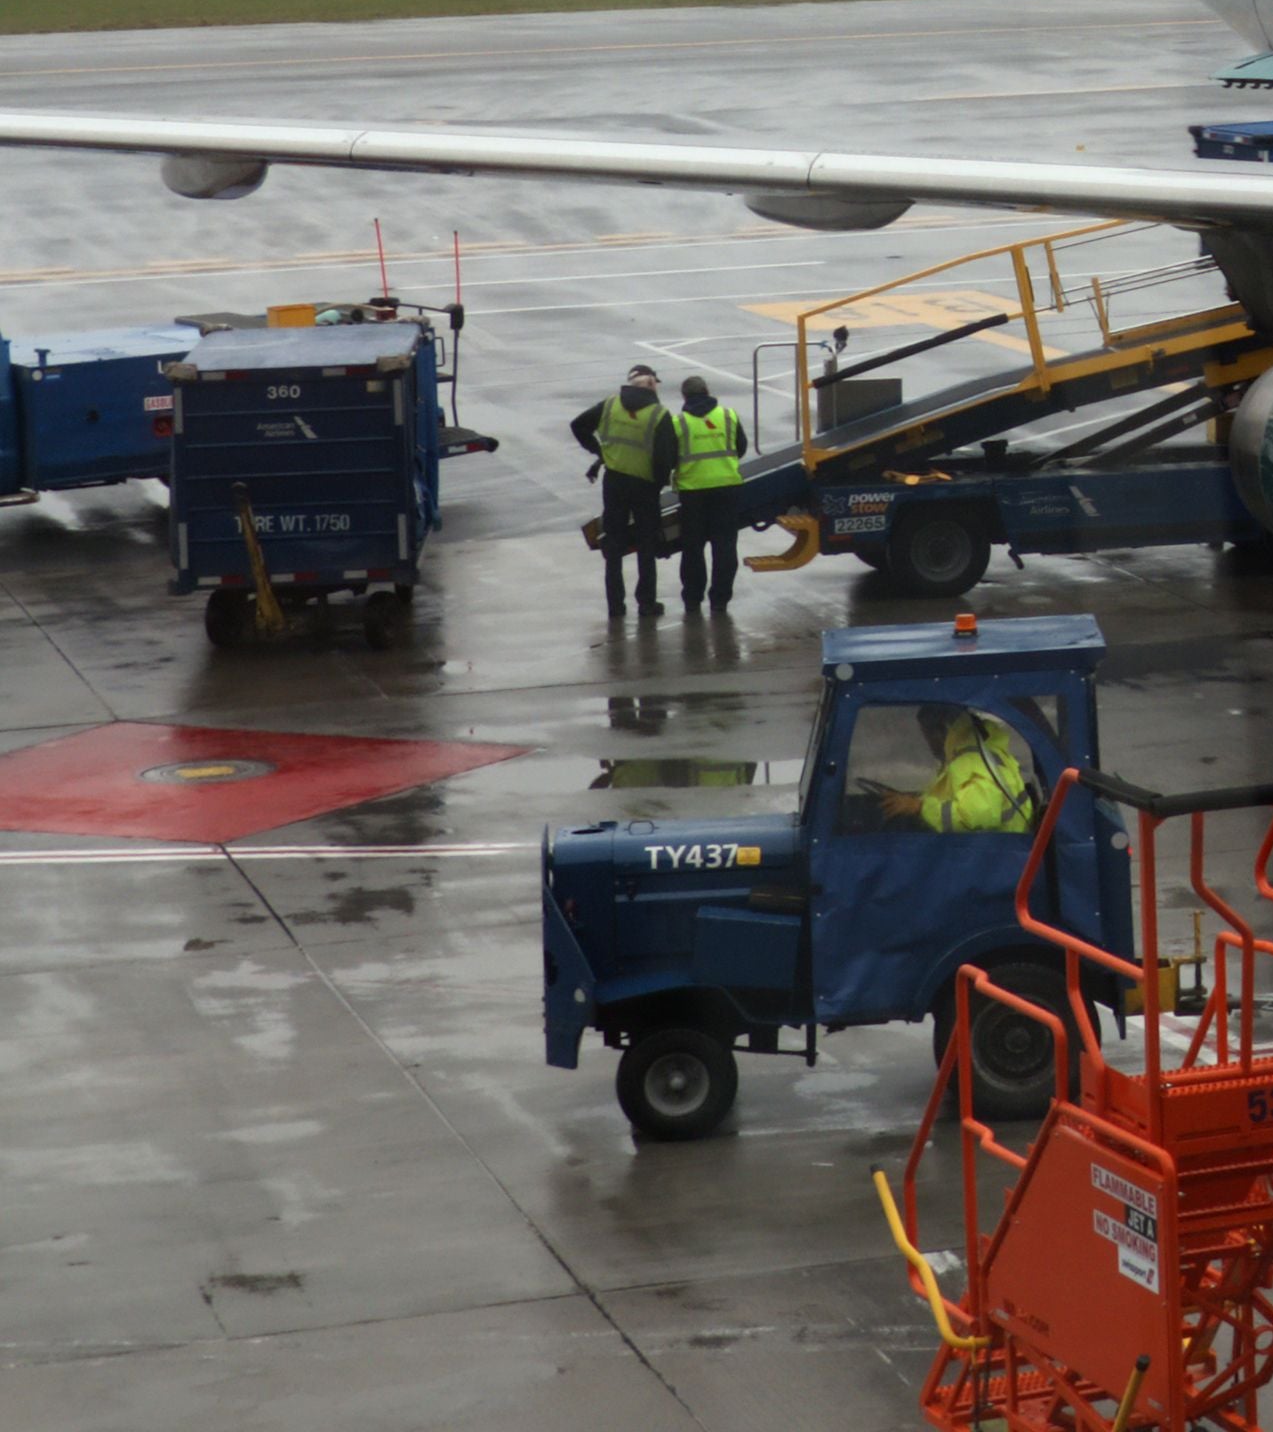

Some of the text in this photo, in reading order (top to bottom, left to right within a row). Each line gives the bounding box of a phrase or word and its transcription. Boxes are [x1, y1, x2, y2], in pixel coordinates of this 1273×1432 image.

[266, 385, 301, 399] 360
[848, 492, 896, 507] power
[234, 515, 275, 533] TRE
[315, 514, 350, 532] 1750
[837, 517, 885, 532] 22265
[644, 843, 739, 869] TY437
[1093, 1166, 1156, 1216] FLAMMABLE
[1128, 1207, 1155, 1238] JET A
[1096, 1213, 1156, 1263] NO SMOKING
